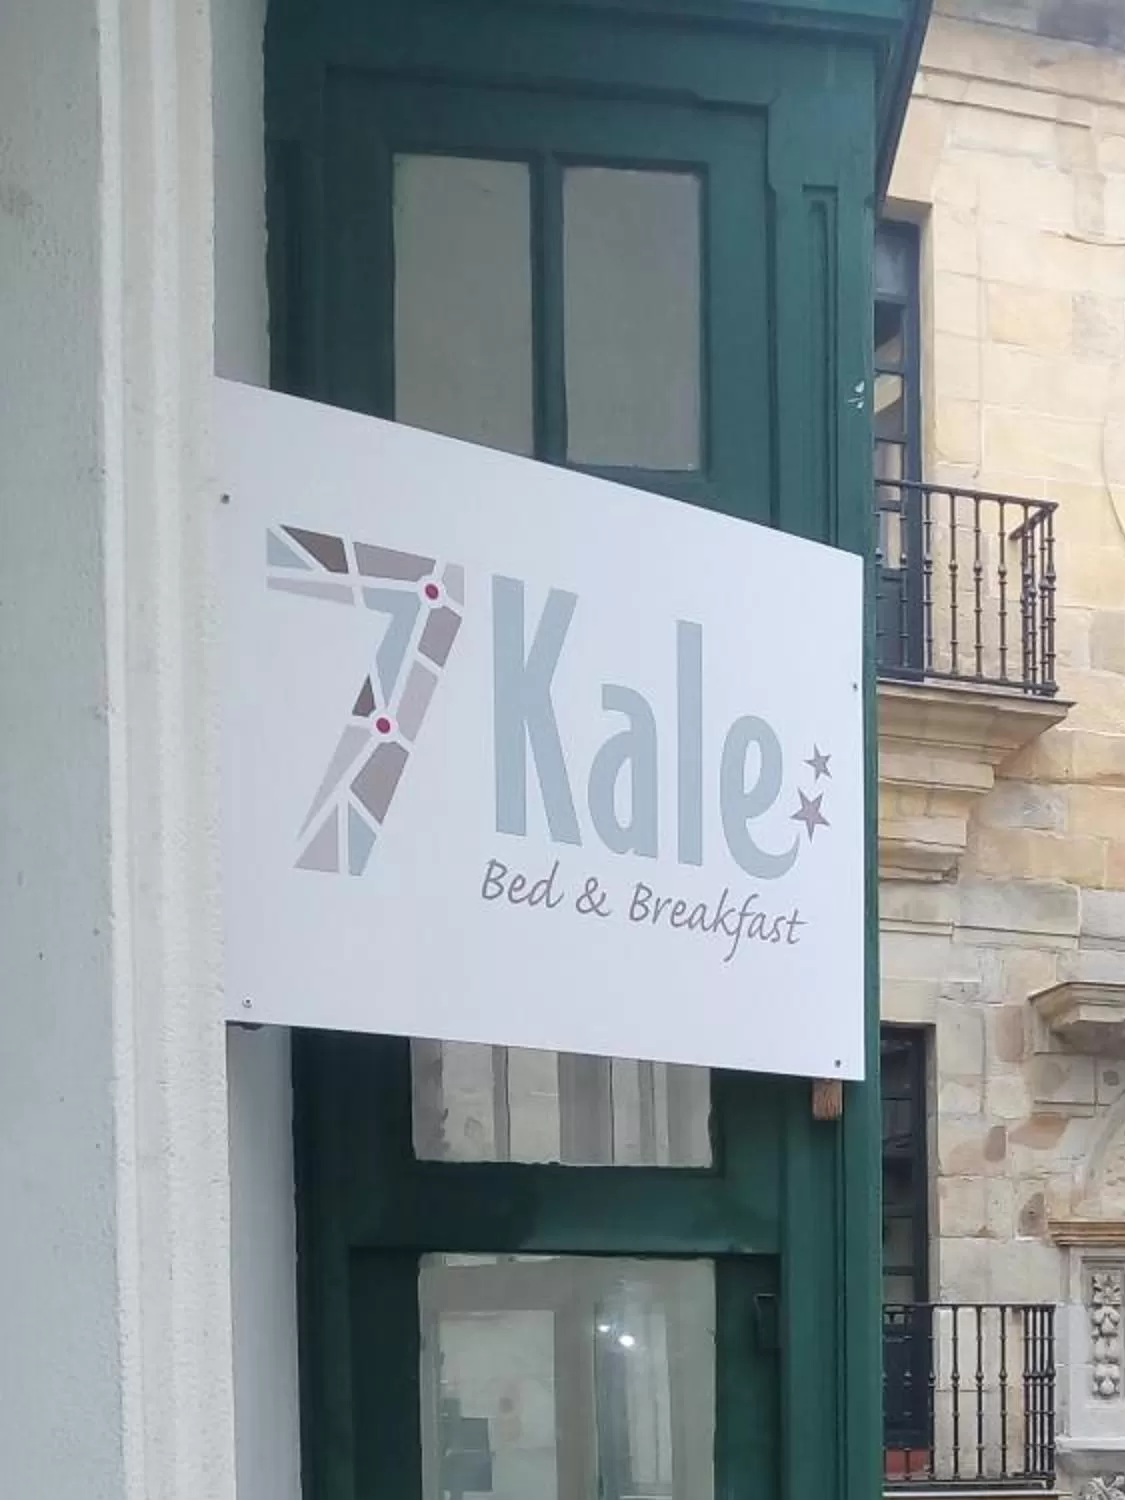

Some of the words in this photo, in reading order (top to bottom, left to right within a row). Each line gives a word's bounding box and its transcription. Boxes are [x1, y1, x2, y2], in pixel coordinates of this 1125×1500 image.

[266, 523, 465, 877] 7
[491, 574, 802, 880] Kale
[481, 858, 564, 909] Bed
[575, 876, 611, 917] &
[629, 882, 809, 963] Breakfast
